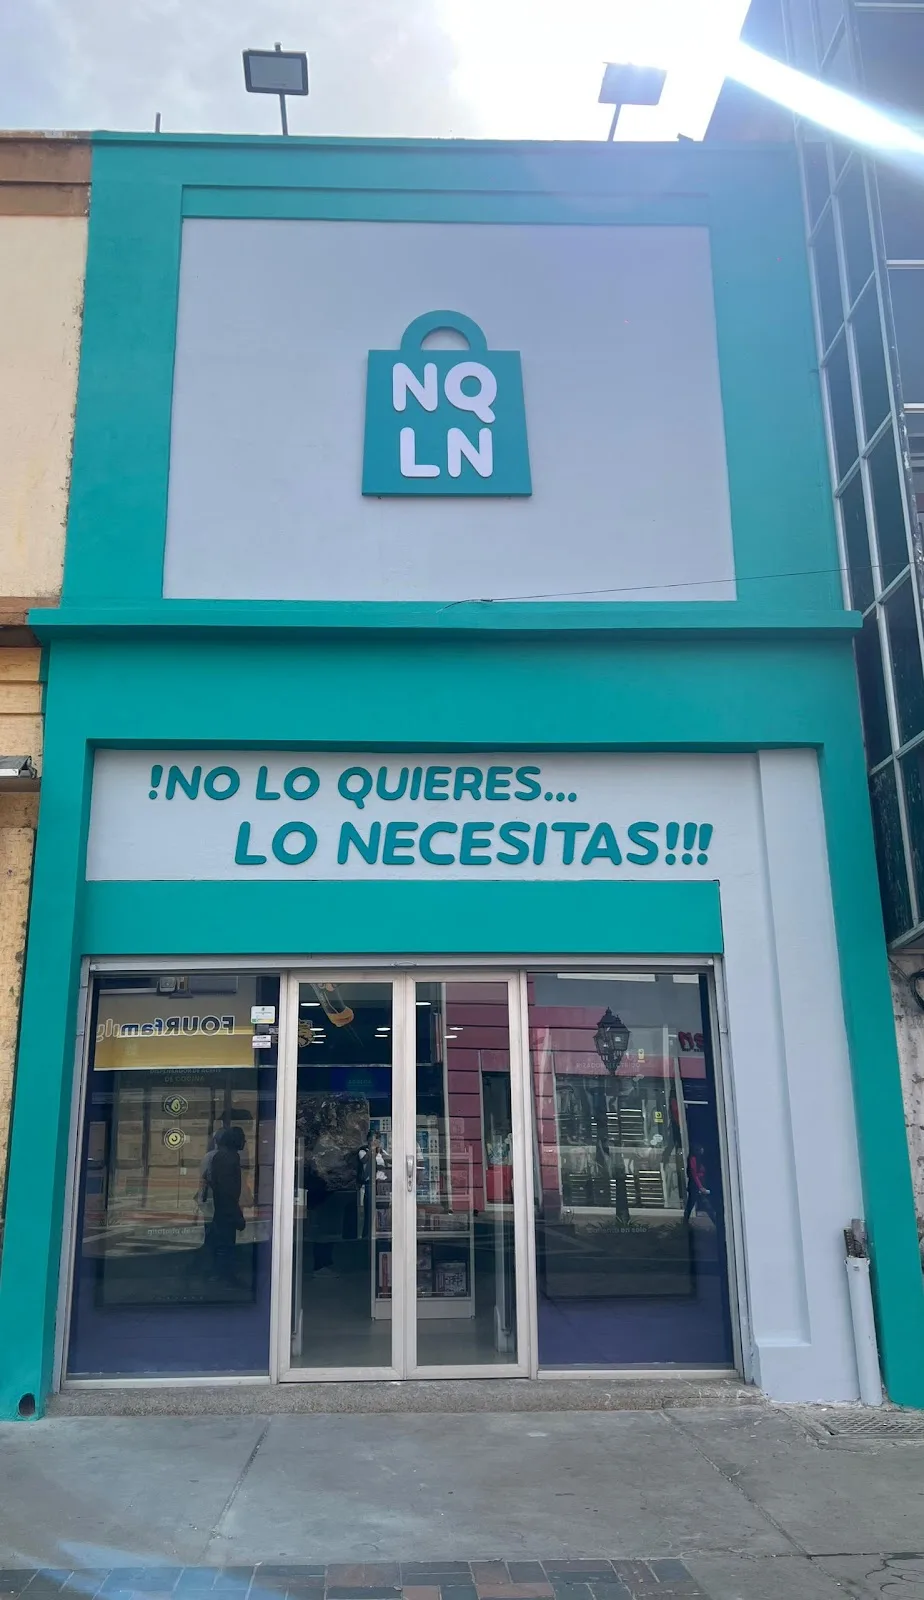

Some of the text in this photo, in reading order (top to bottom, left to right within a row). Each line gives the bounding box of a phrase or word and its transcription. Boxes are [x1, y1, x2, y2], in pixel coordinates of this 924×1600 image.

[392, 361, 498, 424] NQ
[399, 426, 494, 479] LN
[147, 763, 578, 810] !NO LO QUIERES...
[233, 820, 714, 867] LO NECESITAS!!!
